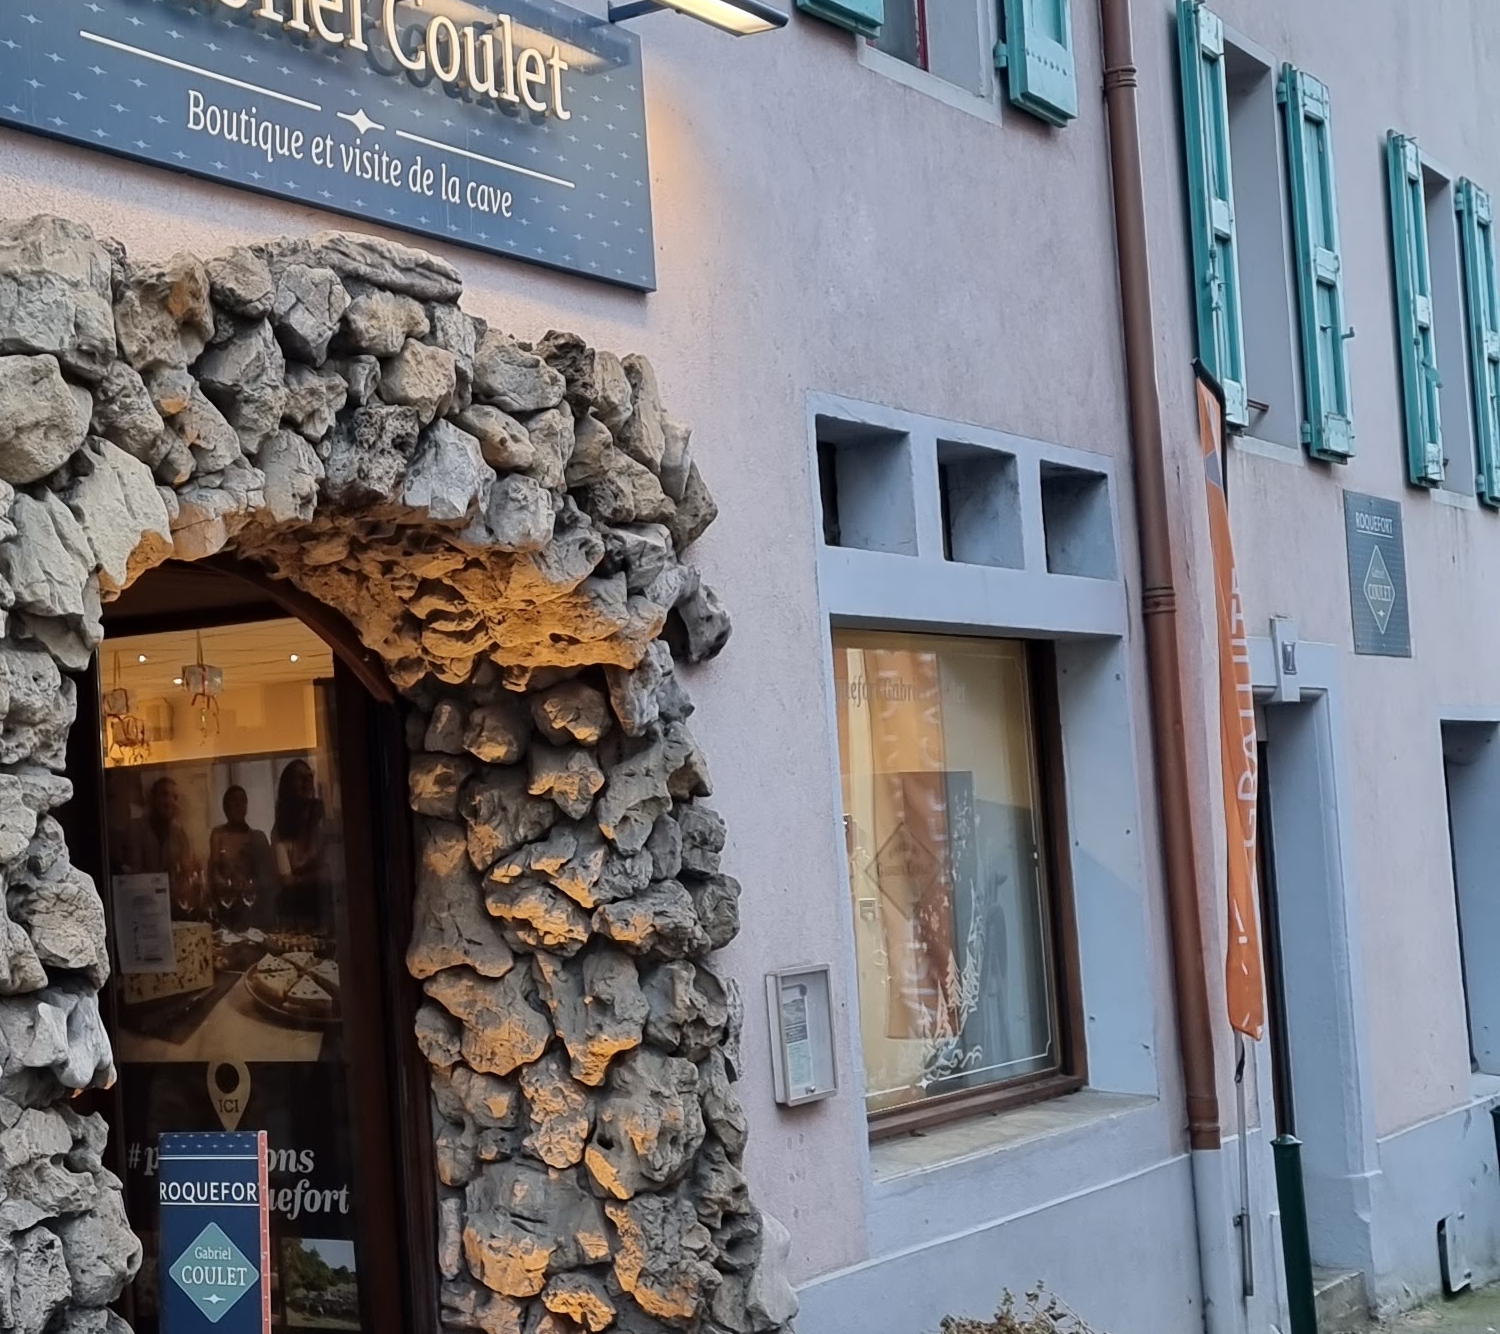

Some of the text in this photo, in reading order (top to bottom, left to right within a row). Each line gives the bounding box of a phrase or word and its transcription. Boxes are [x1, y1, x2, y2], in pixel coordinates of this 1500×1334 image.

[187, 89, 513, 218] Boutique et visite de la cave
[1355, 512, 1393, 531] ROQUEFORT
[219, 1099, 239, 1113] ICI
[159, 1181, 260, 1203] ROQUEFOR
[195, 1247, 231, 1260] Gabriel
[181, 1266, 247, 1286] COULET
